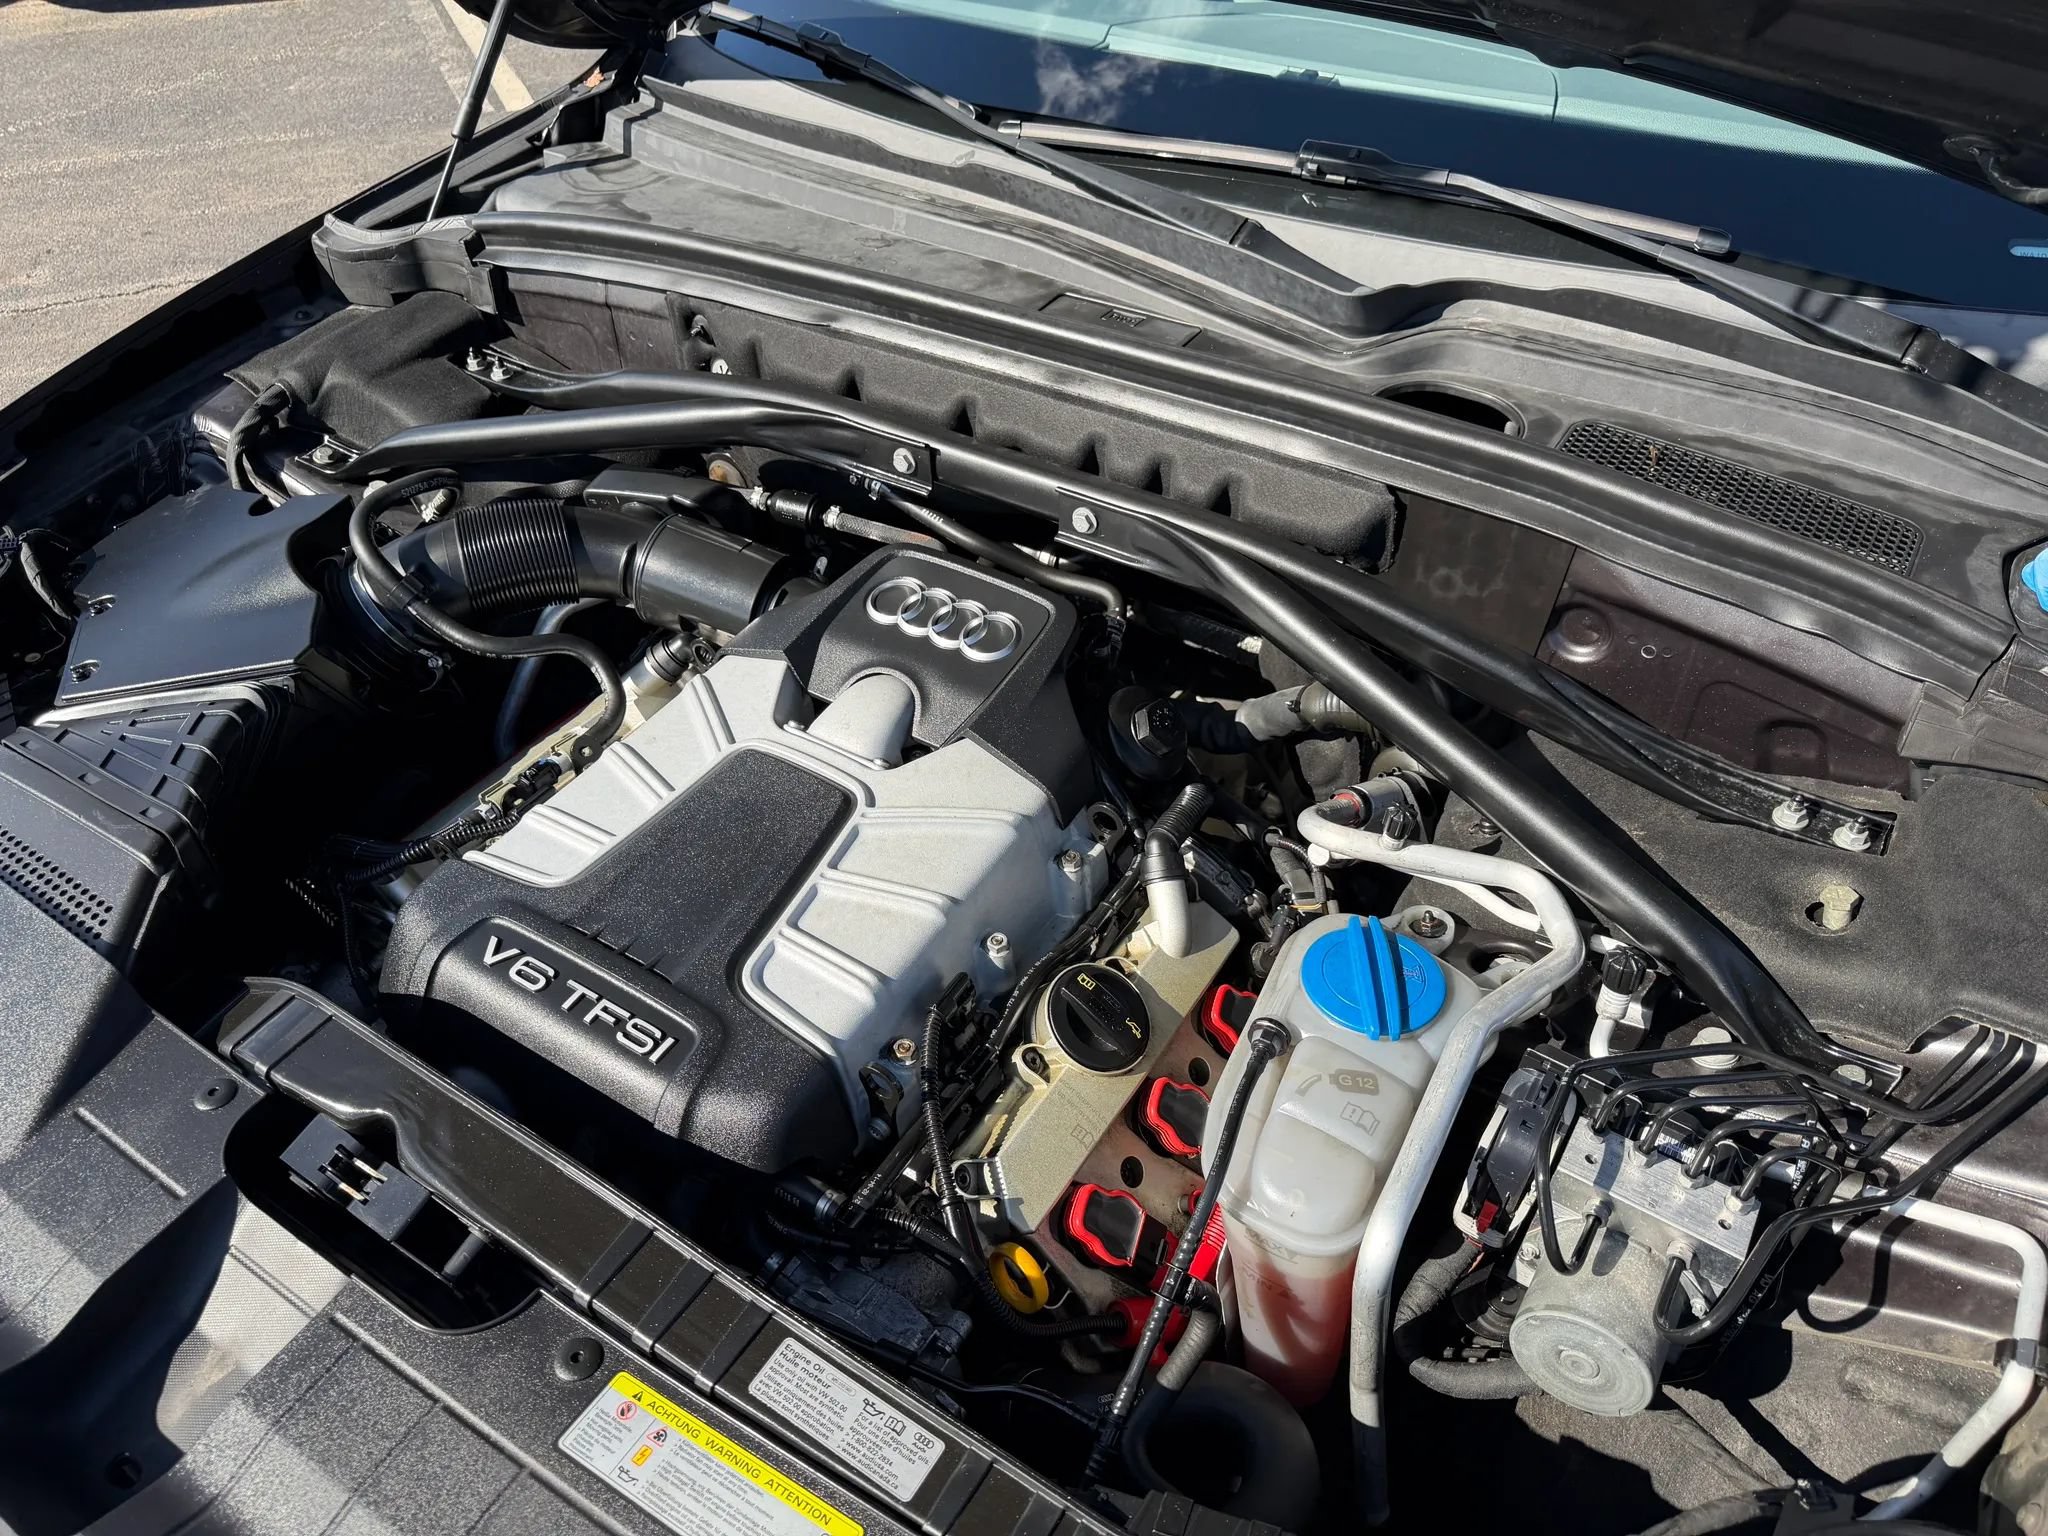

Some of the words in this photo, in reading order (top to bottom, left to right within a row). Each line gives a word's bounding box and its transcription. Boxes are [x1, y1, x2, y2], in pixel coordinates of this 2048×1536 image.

[483, 935, 558, 993] V6
[561, 979, 678, 1065] TFSI
[1338, 1075, 1353, 1087] G
[1355, 1077, 1376, 1090] 12
[1245, 1226, 1283, 1252] MAX
[778, 1350, 801, 1368] Huile
[799, 1364, 832, 1390] moteur
[783, 1342, 813, 1366] Engine
[811, 1362, 826, 1374] Oil
[753, 1383, 762, 1392] La
[760, 1388, 782, 1407] plupart
[780, 1403, 794, 1415] sont
[758, 1378, 772, 1390] avec
[771, 1387, 783, 1397] VW
[781, 1394, 794, 1405] 502
[792, 1401, 802, 1411] 00
[762, 1371, 784, 1388] Utiliser
[781, 1385, 817, 1412] uniquement
[815, 1408, 828, 1419] des
[826, 1415, 845, 1432] huiles
[767, 1364, 795, 1386] approval.
[793, 1382, 809, 1395] Most
[808, 1392, 818, 1402] are
[772, 1357, 785, 1369] Use
[783, 1365, 798, 1378] only
[796, 1374, 806, 1383] oil
[804, 1380, 818, 1392] with
[817, 1389, 829, 1400] VW
[827, 1396, 840, 1407] 502
[838, 1403, 848, 1413] 00
[853, 1417, 869, 1431] Pour
[867, 1428, 879, 1439] une
[878, 1435, 894, 1448] liste
[857, 1411, 869, 1422] For
[872, 1422, 884, 1433] list
[881, 1428, 891, 1437] of
[888, 1434, 919, 1457] approved
[911, 1440, 927, 1453] Audi
[645, 1398, 703, 1439] ACHTUNG
[702, 1436, 763, 1479] WARNING
[762, 1476, 833, 1526] ATTENTION
[840, 1445, 900, 1490] www.audicanada.ca
[844, 1439, 900, 1481] www.audiusa.com
